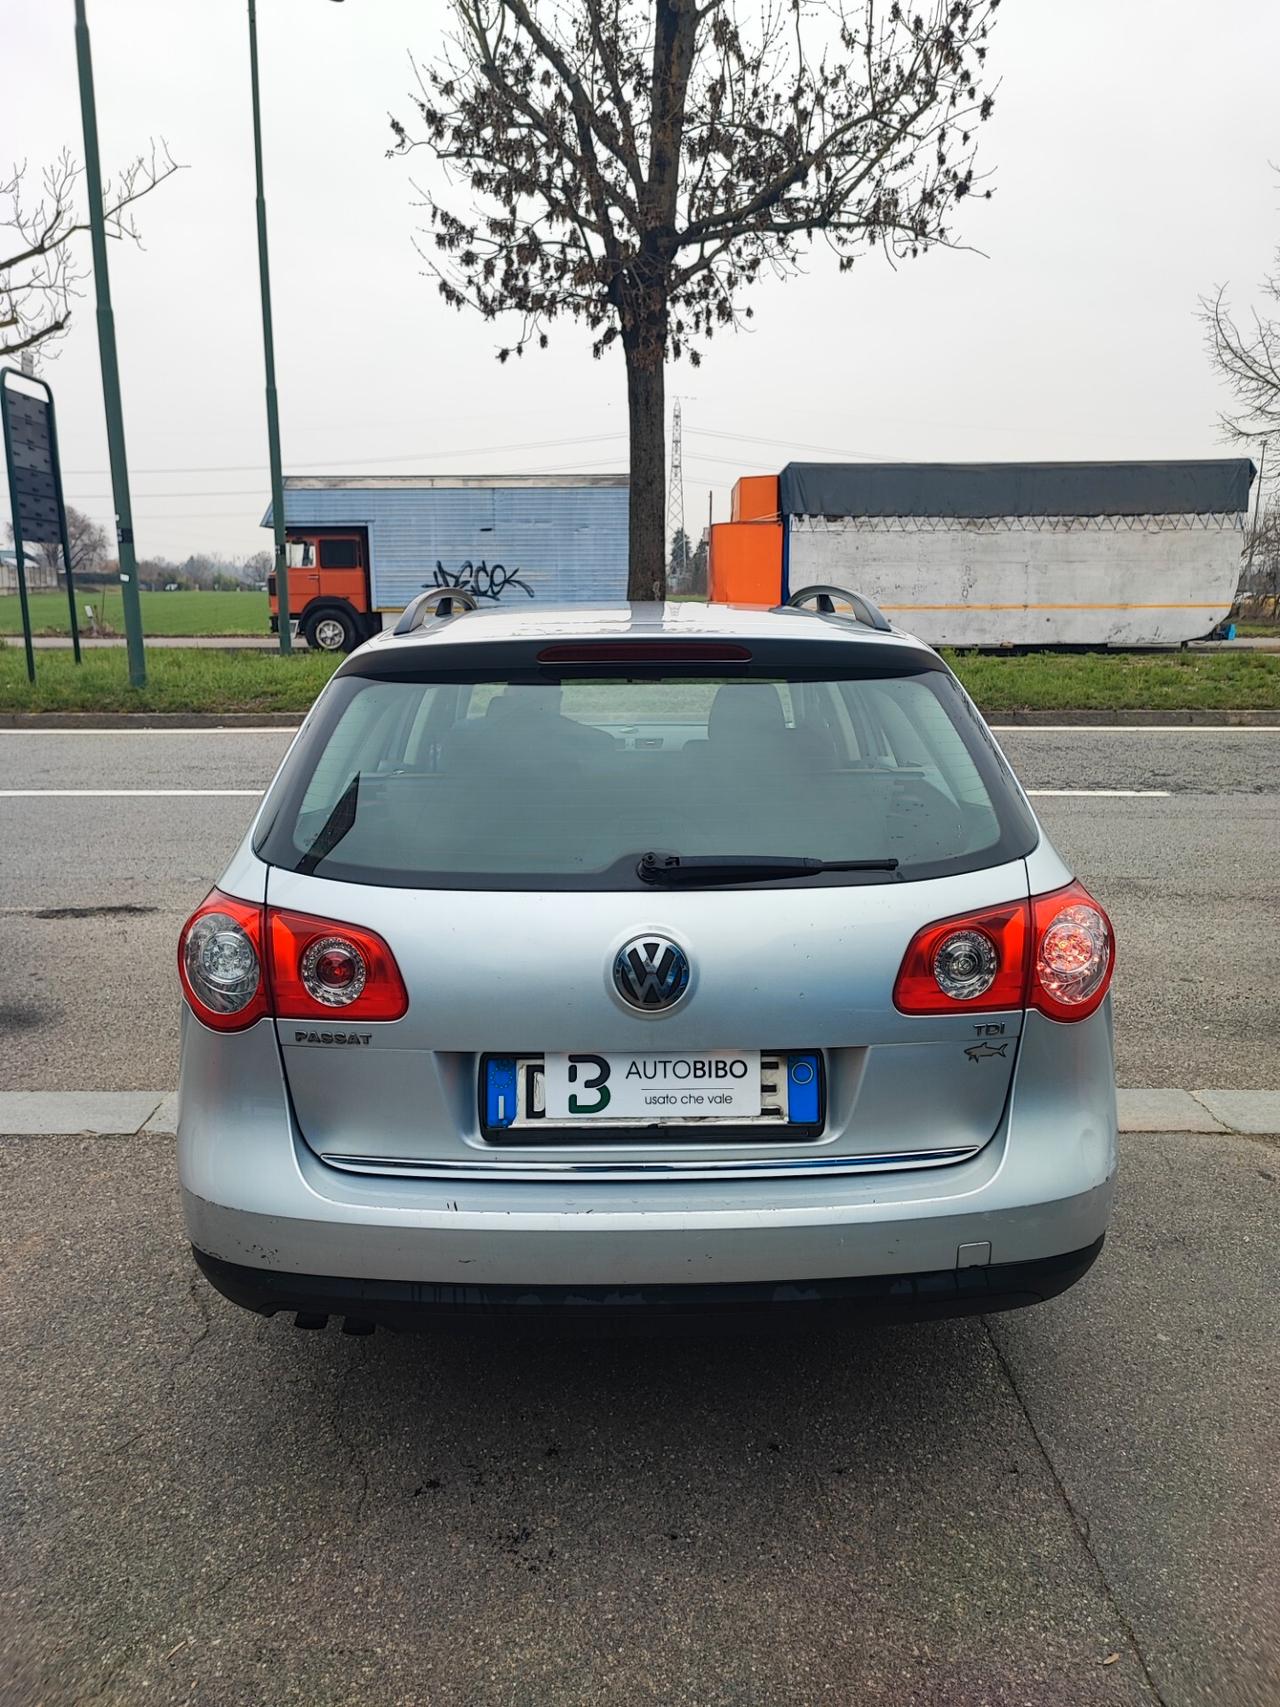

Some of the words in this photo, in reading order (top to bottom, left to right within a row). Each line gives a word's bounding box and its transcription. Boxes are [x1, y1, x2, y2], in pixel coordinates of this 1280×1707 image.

[973, 1022, 1006, 1036] TDI
[294, 1030, 372, 1045] PASSAT
[625, 1060, 748, 1079] AUTOBIBO
[644, 1093, 678, 1105] usato
[680, 1092, 704, 1104] che
[708, 1092, 733, 1104] vale
